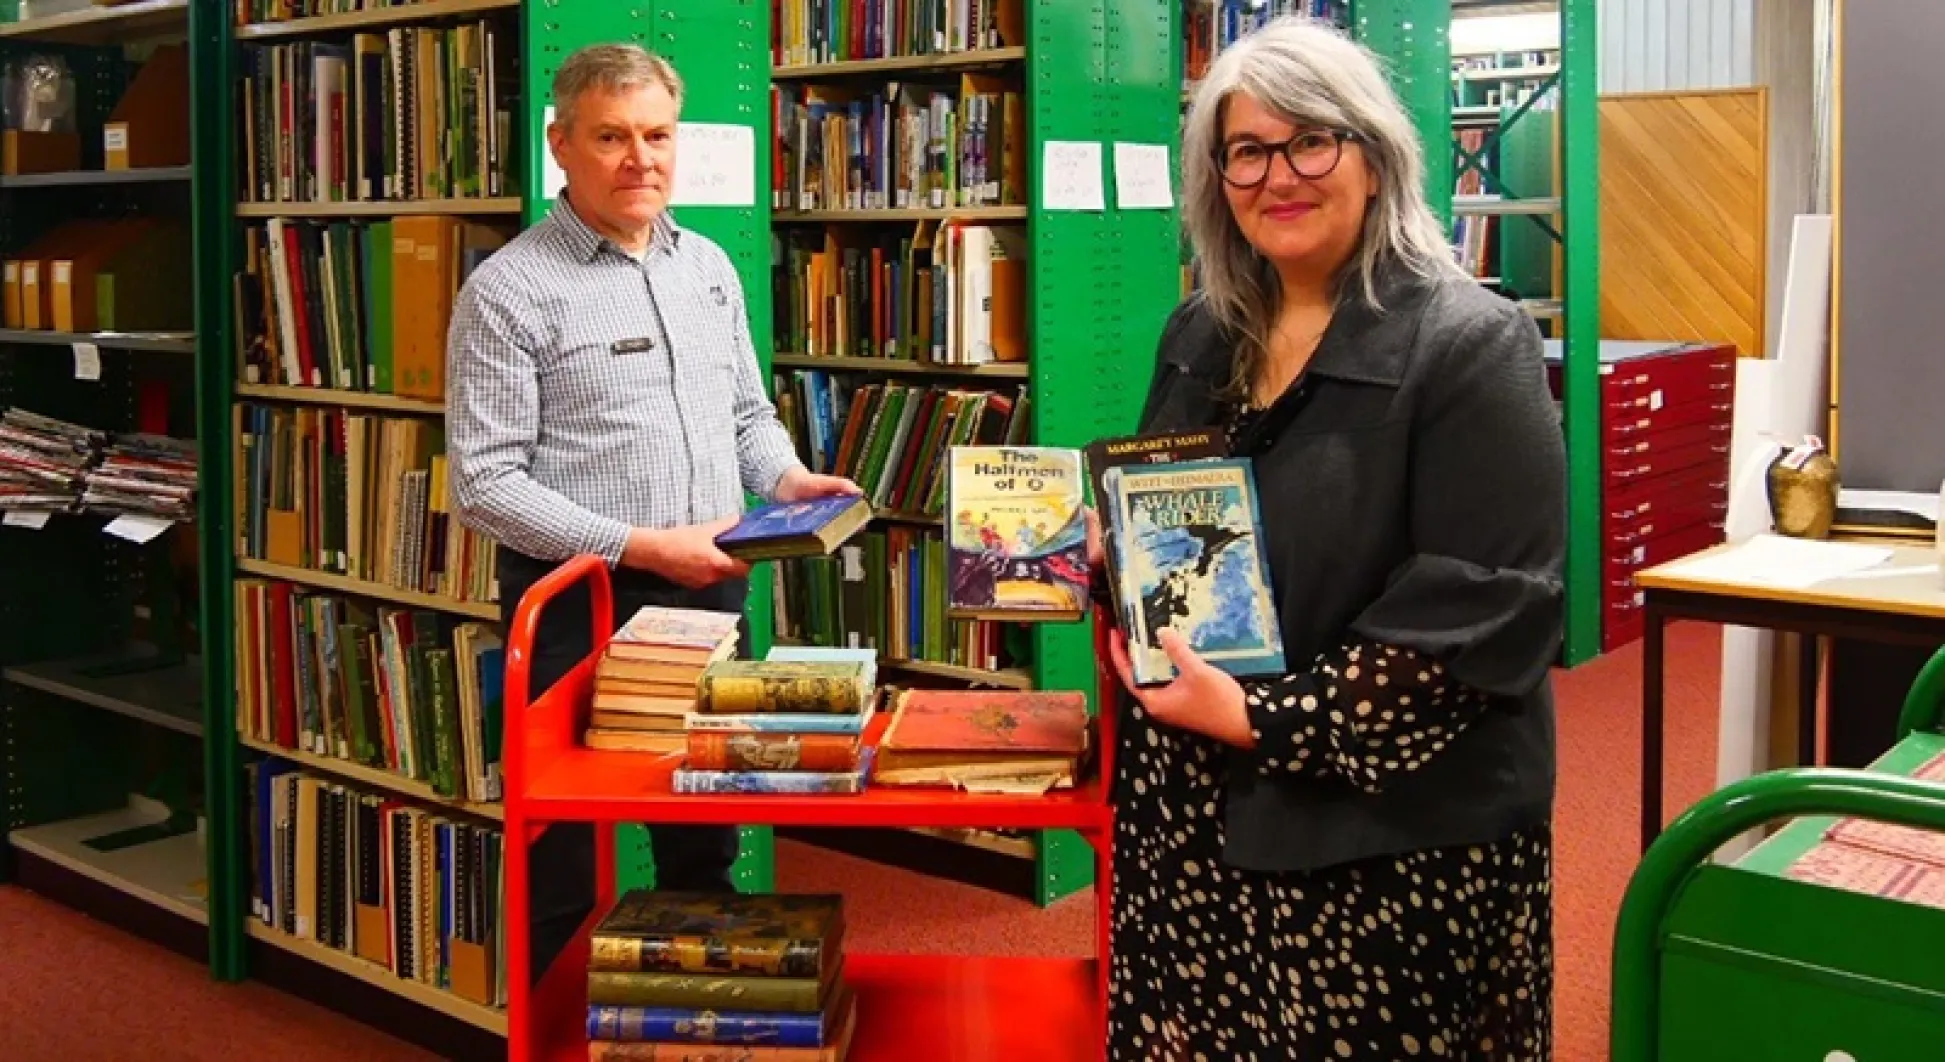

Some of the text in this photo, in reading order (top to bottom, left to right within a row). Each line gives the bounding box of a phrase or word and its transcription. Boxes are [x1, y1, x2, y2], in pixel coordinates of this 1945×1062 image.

[999, 450, 1038, 462] The
[974, 463, 1063, 477] Halfmen
[994, 478, 1043, 491] of O
[1143, 490, 1224, 509] WHALE
[1157, 506, 1222, 526] RIDER
